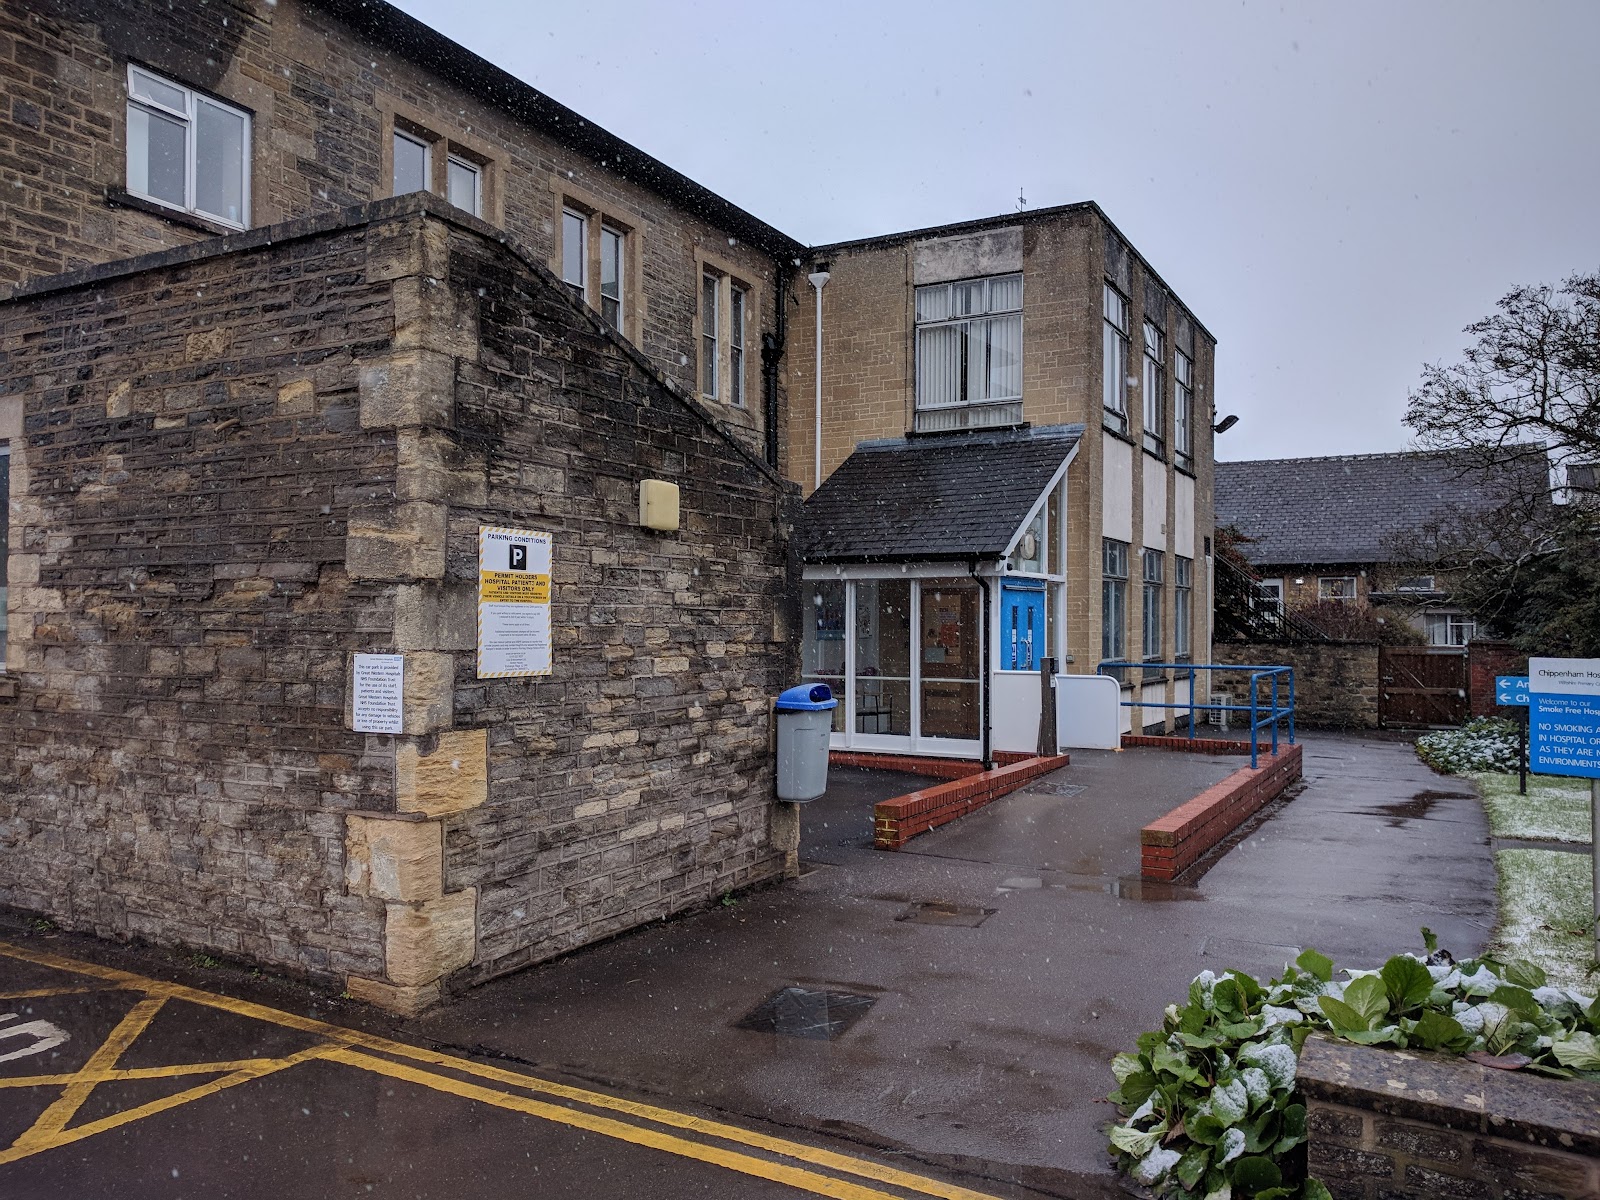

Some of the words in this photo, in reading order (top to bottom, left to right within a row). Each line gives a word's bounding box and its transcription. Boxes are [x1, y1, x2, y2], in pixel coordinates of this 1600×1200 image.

[488, 534, 512, 542] PARKING
[513, 548, 523, 566] P
[1538, 670, 1584, 678] Chippenham
[1554, 724, 1592, 733] SMOKING
[1550, 735, 1587, 744] HOSPITAL
[1553, 746, 1574, 754] THEY
[1576, 748, 1593, 756] ARE
[1539, 756, 1600, 768] ENVIRONMENTS
